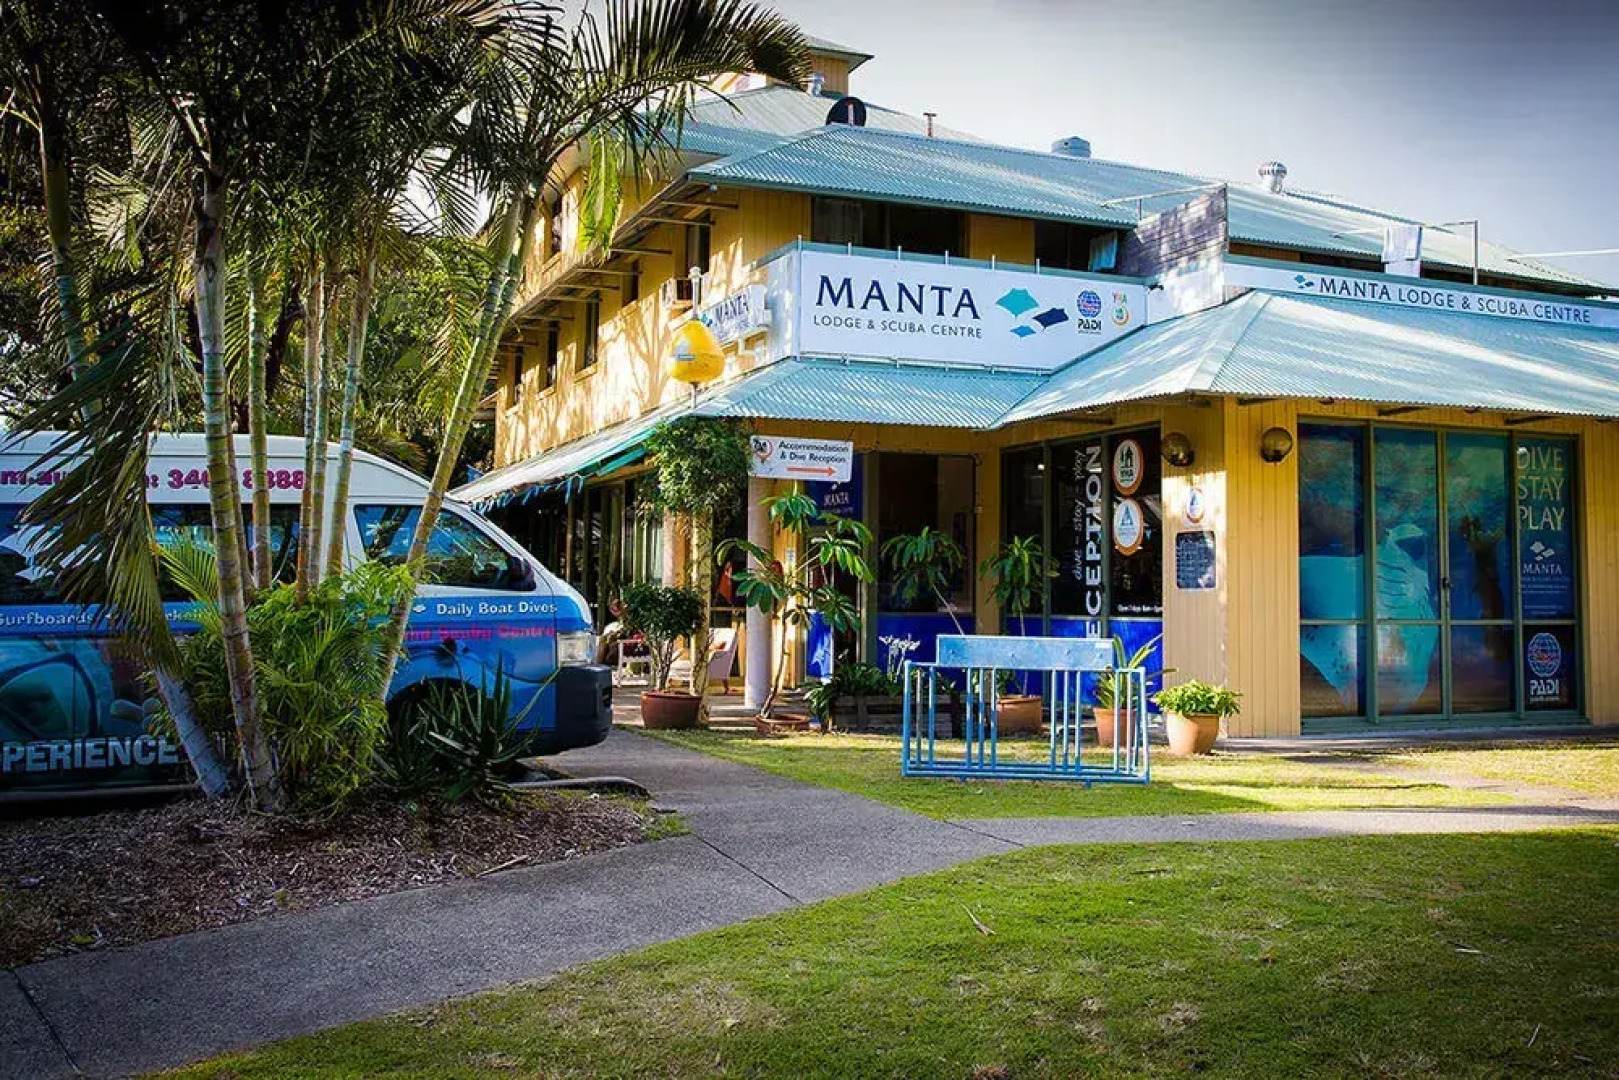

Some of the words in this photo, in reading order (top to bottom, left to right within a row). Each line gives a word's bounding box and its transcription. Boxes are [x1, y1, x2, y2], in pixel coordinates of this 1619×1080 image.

[816, 275, 981, 320] MANTA
[1320, 277, 1391, 300] MANTA
[1399, 288, 1454, 308] LODGE
[1462, 295, 1471, 310] &
[1477, 297, 1528, 316] SCUBA
[1533, 304, 1590, 323] CENTRE
[814, 315, 861, 329] LODGE
[867, 319, 875, 330] &
[881, 320, 926, 333] SCUBA
[931, 323, 982, 339] CENTRE
[1078, 318, 1102, 331] PADI
[779, 440, 849, 453] Accommodation
[780, 451, 786, 459] &
[789, 452, 807, 461] Dive
[809, 453, 846, 463] Reception
[1516, 446, 1564, 471] DIVE
[1516, 475, 1565, 502] STAY
[1517, 506, 1565, 531] PLAY
[1085, 446, 1102, 638] ECEPTION
[1522, 563, 1563, 575] MANTA
[436, 602, 474, 617] Daily
[478, 602, 514, 614] Boat
[518, 601, 558, 614] Dives
[498, 624, 556, 638] Centre
[1529, 679, 1560, 696] PADI
